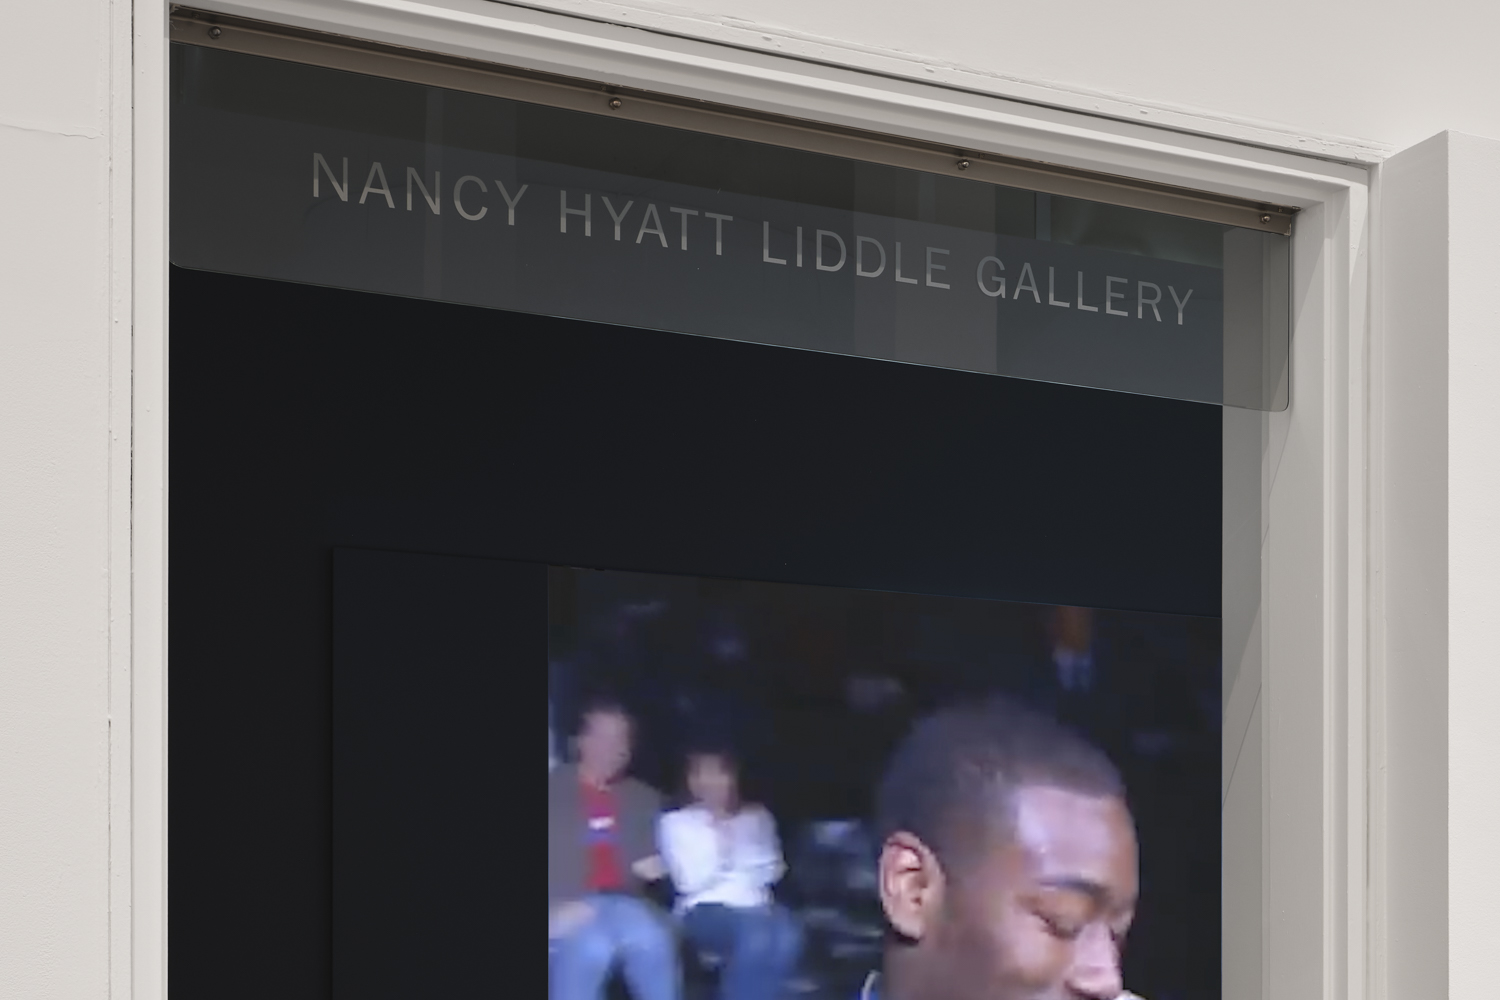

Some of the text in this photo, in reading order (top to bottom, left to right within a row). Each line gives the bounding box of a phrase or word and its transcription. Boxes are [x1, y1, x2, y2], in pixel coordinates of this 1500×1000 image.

[312, 152, 1194, 326] NANCY HYATT LIDDLE GALLERY
